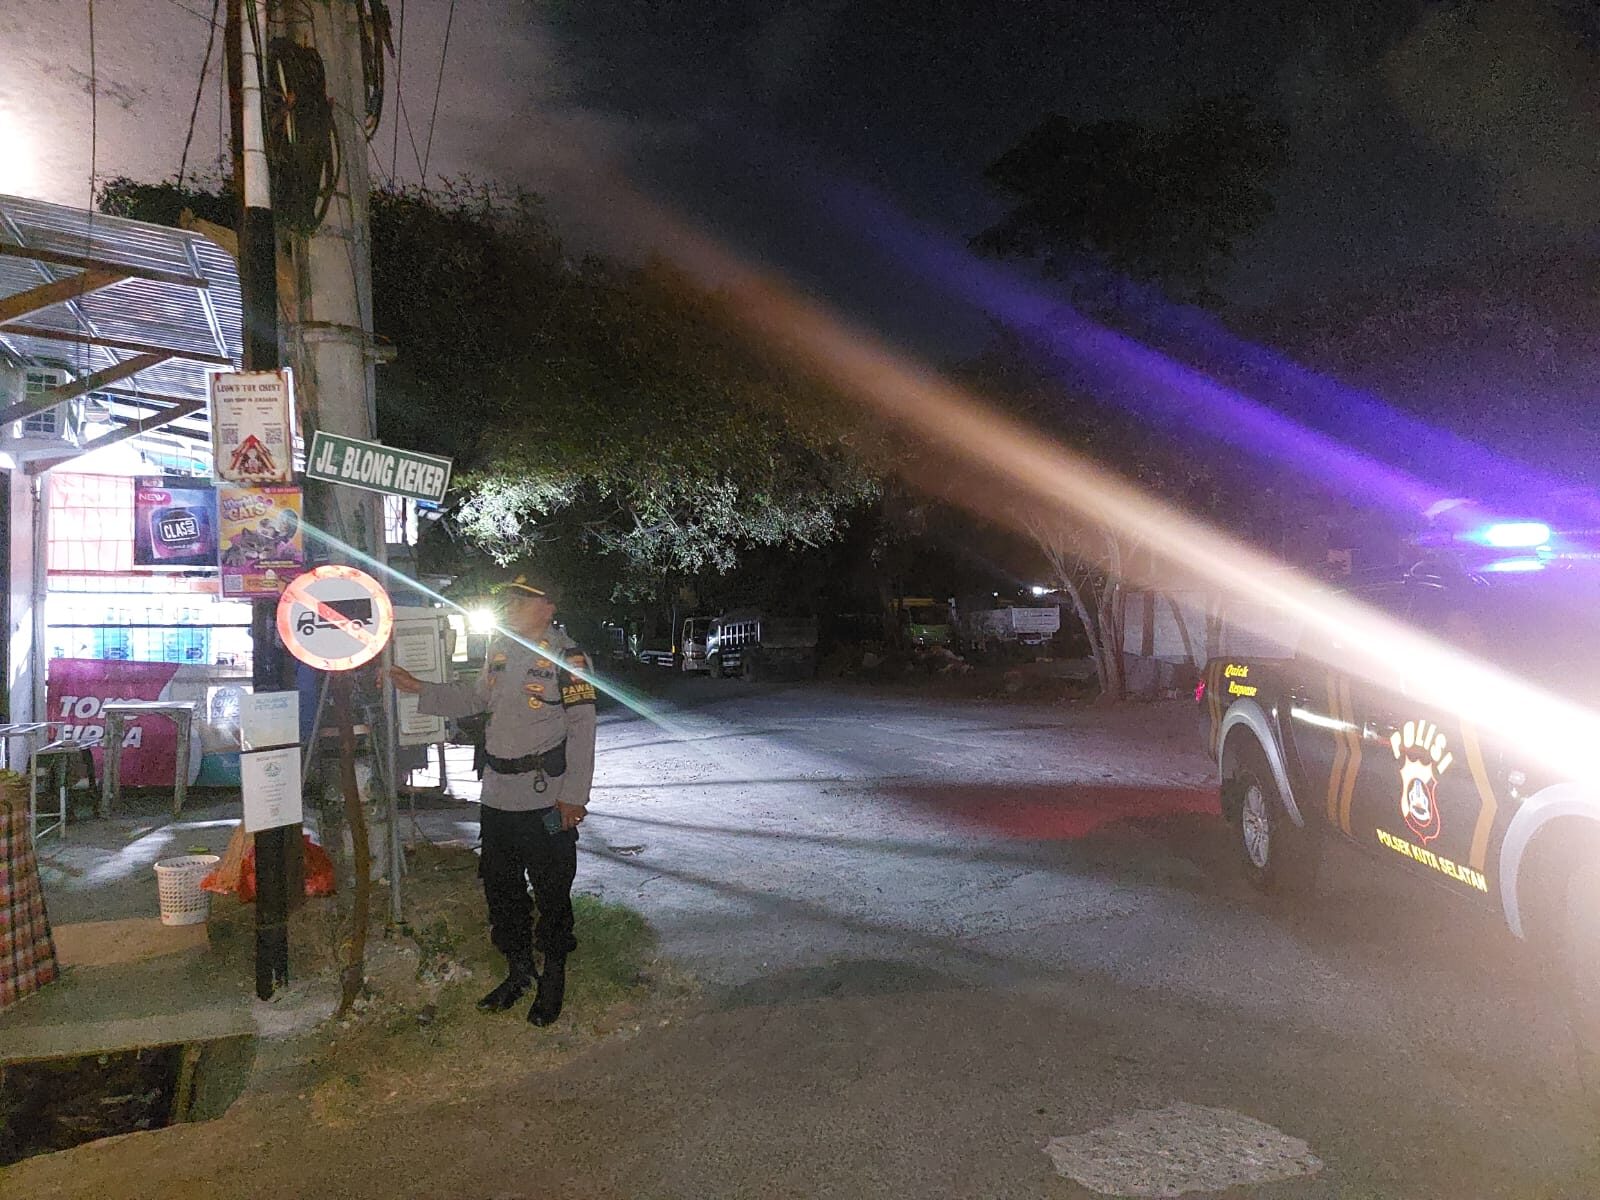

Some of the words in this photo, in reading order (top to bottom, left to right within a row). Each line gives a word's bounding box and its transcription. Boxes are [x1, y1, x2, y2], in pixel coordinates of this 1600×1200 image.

[316, 441, 338, 474] JL.
[341, 446, 395, 486] BLONG
[394, 457, 445, 497] KEKER
[138, 493, 166, 502] NEW
[228, 502, 266, 521] CATS
[1224, 664, 1249, 678] Quick
[1228, 681, 1258, 697] Response
[60, 695, 146, 721] TO
[1390, 718, 1454, 776] POLISI
[1376, 828, 1413, 858] POLSEK
[1411, 844, 1441, 872] KUTA
[1440, 856, 1488, 893] SELATAN
